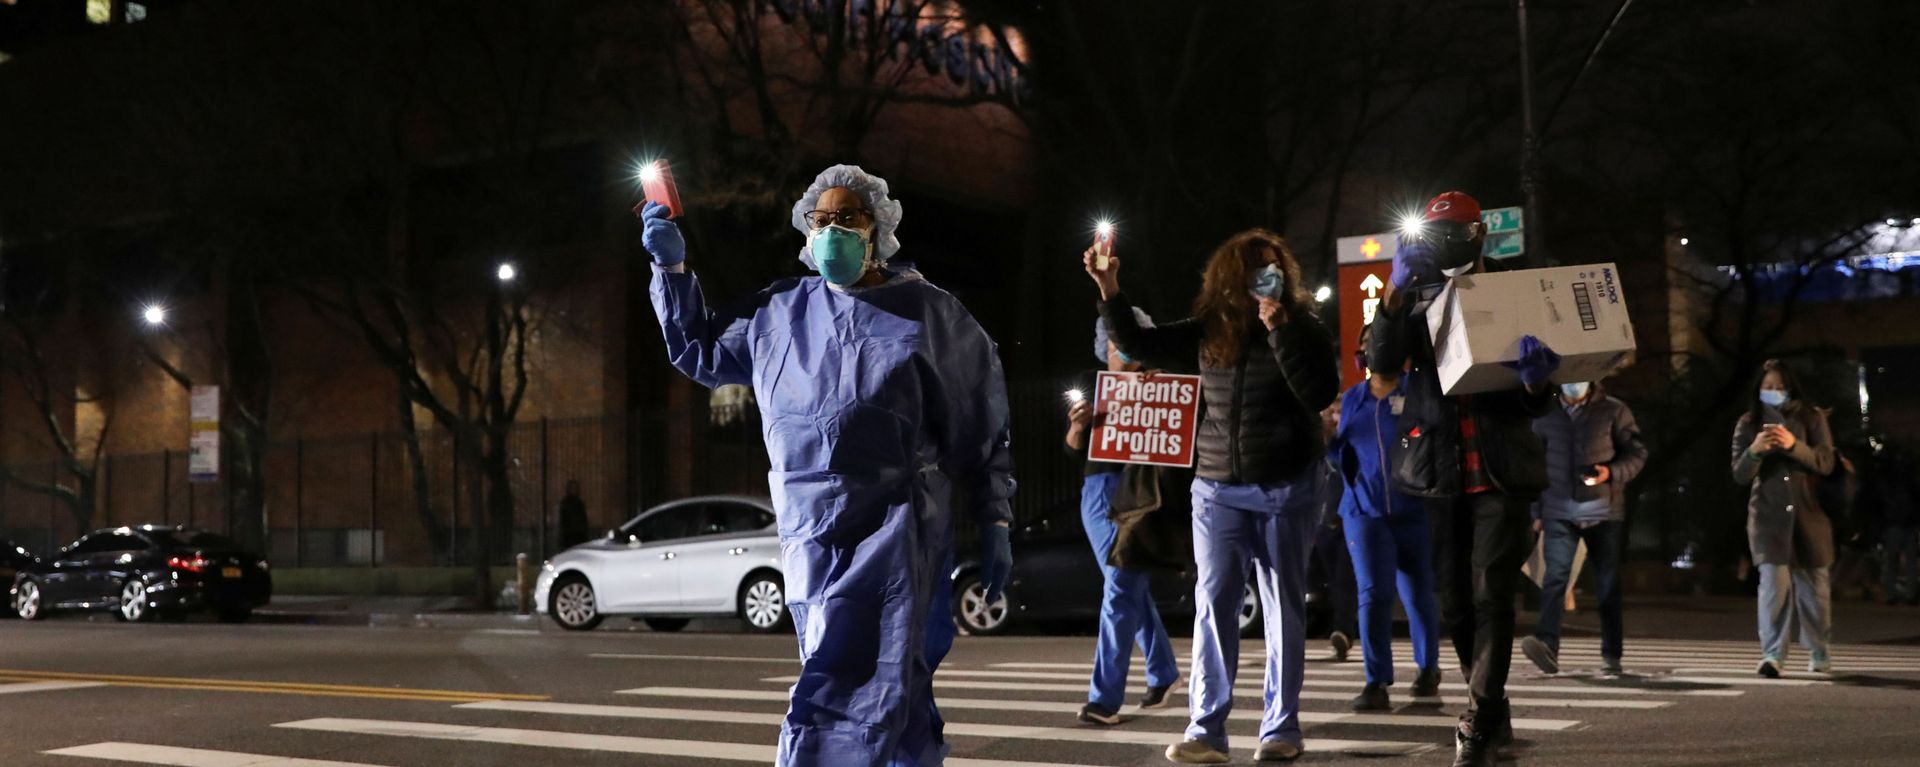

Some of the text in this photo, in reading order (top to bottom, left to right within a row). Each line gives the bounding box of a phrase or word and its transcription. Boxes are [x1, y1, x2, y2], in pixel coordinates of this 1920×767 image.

[1101, 376, 1193, 404] Patients
[1105, 401, 1182, 429] Before
[1101, 426, 1182, 455] Profits
